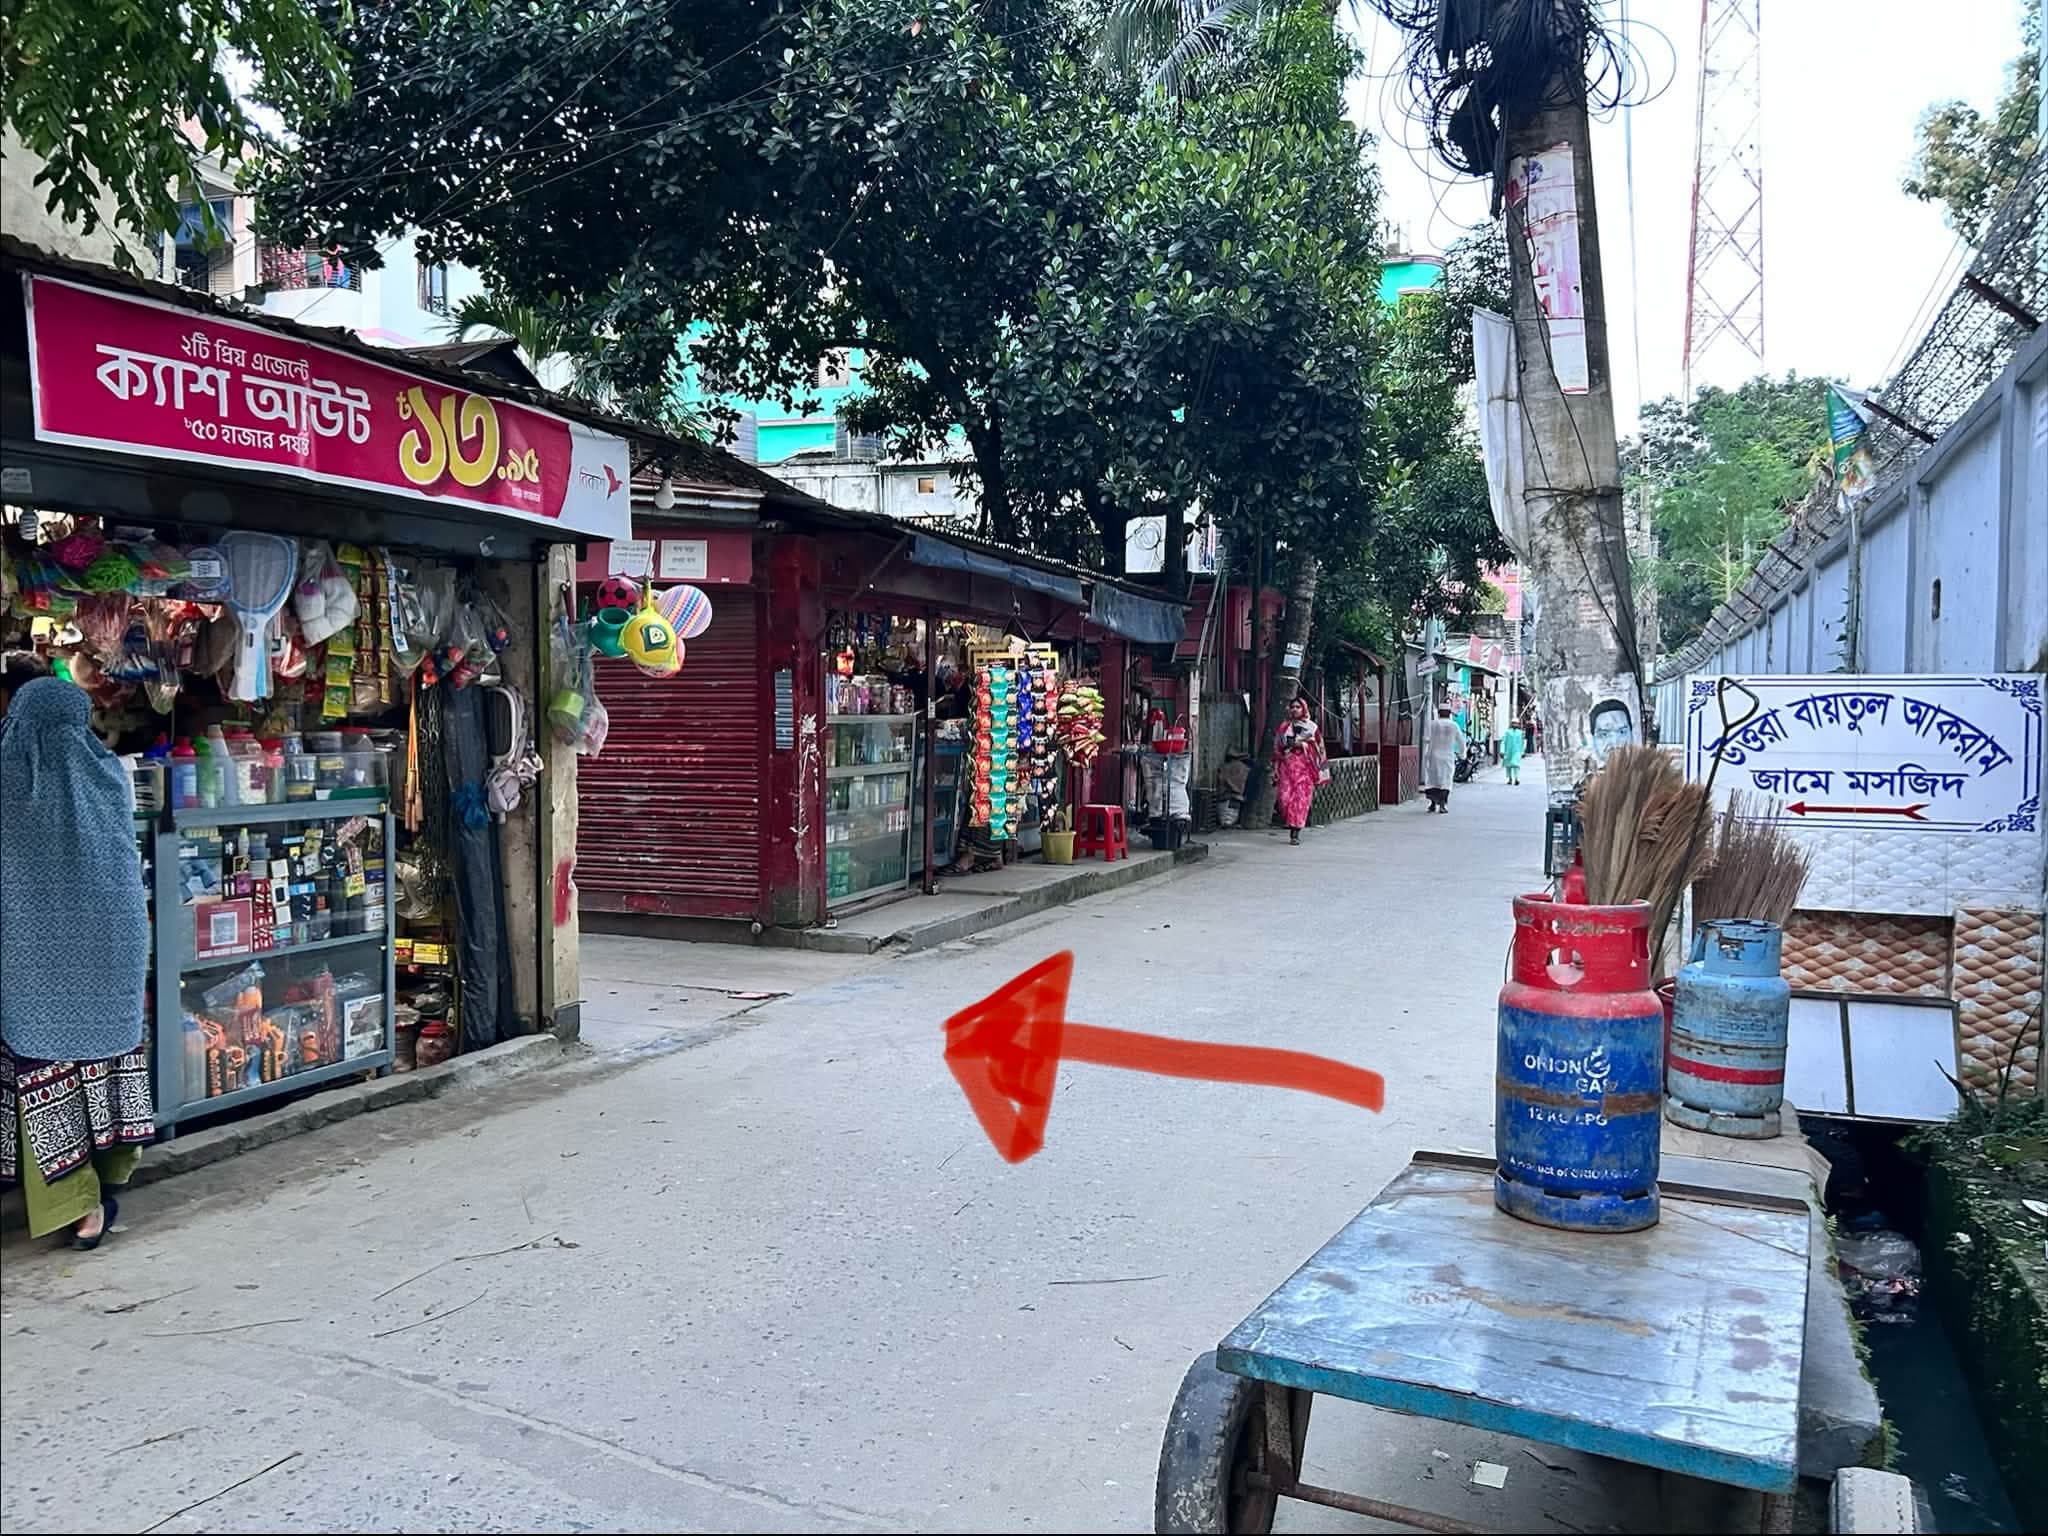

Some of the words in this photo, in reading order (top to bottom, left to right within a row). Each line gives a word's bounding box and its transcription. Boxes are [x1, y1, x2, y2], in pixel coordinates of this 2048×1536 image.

[181, 332, 210, 359] ২টি
[214, 339, 247, 368] প্রিয়
[251, 351, 309, 381] এজেন্টে
[96, 343, 231, 418] ক্যাশ
[242, 374, 371, 444] আউট
[221, 424, 274, 449] হাজার
[1703, 708, 1789, 765] উত্তরা
[1785, 692, 1895, 737] বায়তুল
[1902, 696, 2014, 777] আকরাম
[1748, 768, 1834, 794] জামে
[1843, 763, 1969, 798] মসজিদ
[1524, 1055, 1582, 1075] ORION
[1528, 1106, 1543, 1121] 12
